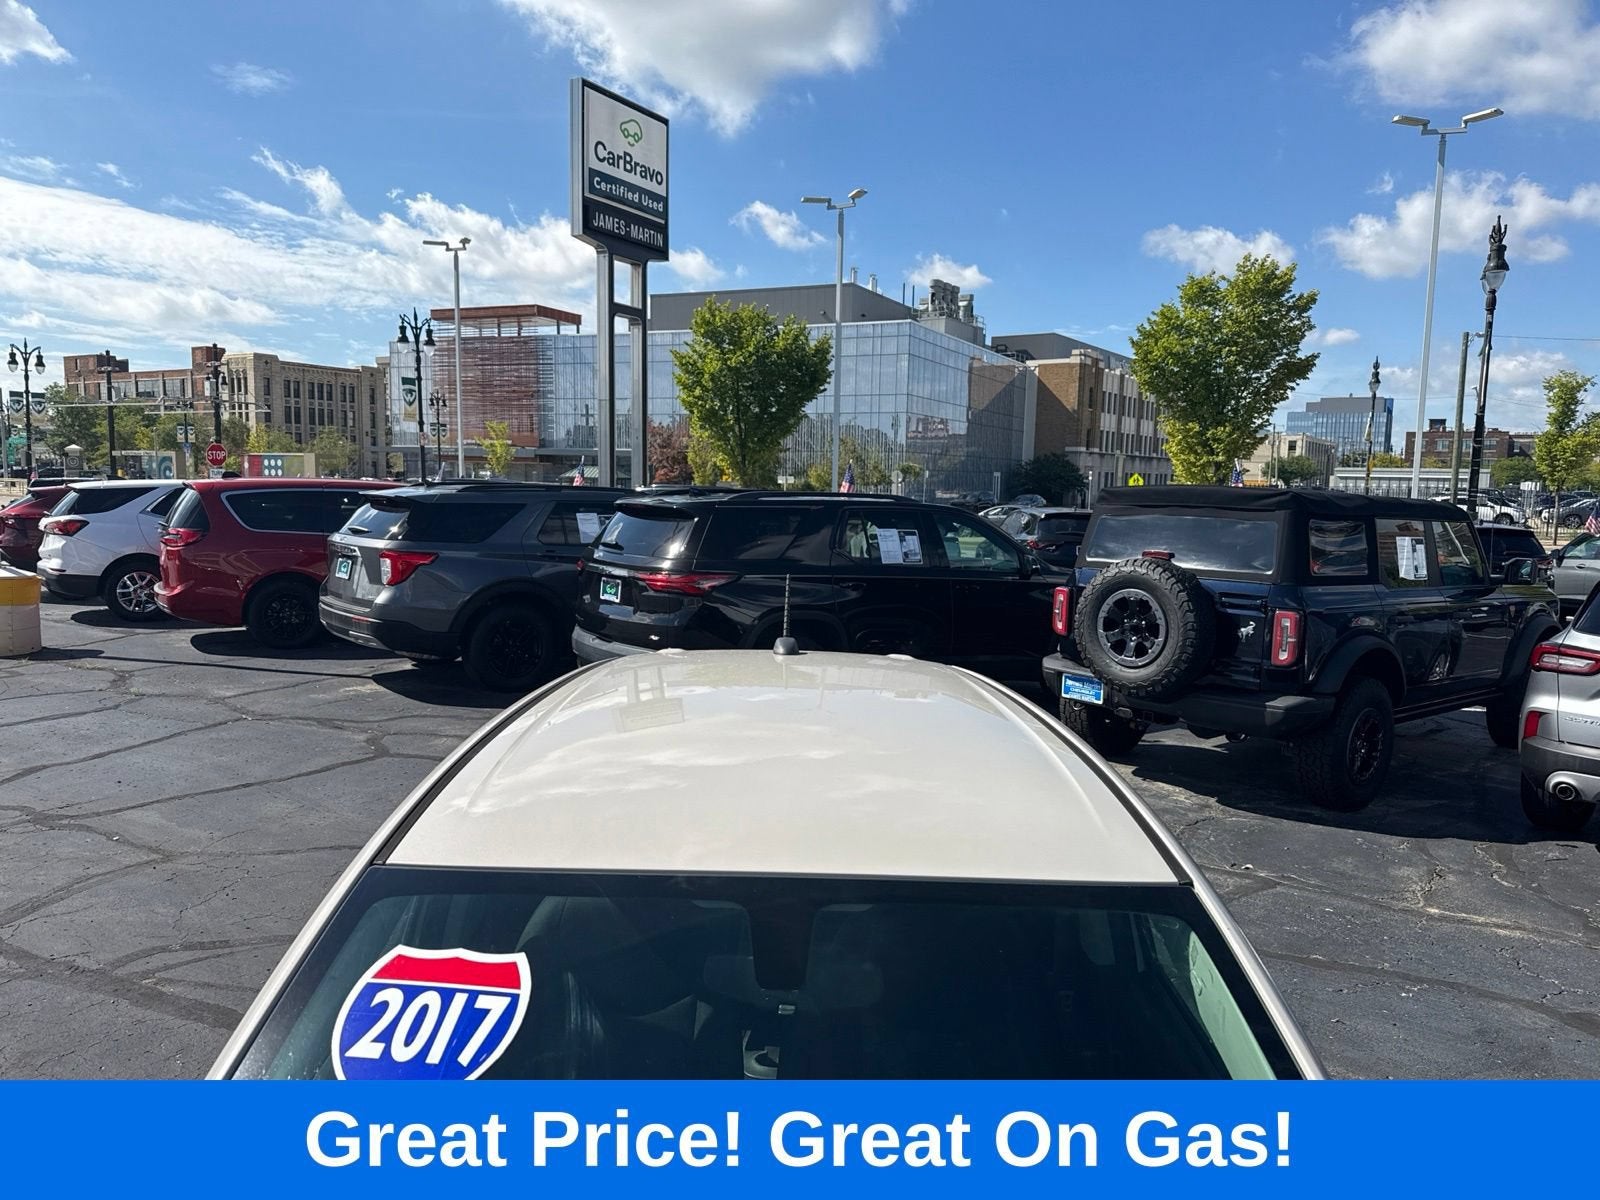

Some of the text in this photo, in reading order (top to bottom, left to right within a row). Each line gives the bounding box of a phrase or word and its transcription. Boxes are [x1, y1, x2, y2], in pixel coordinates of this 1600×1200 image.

[594, 140, 664, 186] CarBravo
[593, 176, 664, 212] Certified Used
[592, 211, 664, 247] JAMES-MARTIN
[207, 450, 226, 460] STOP
[344, 987, 512, 1068] 2017
